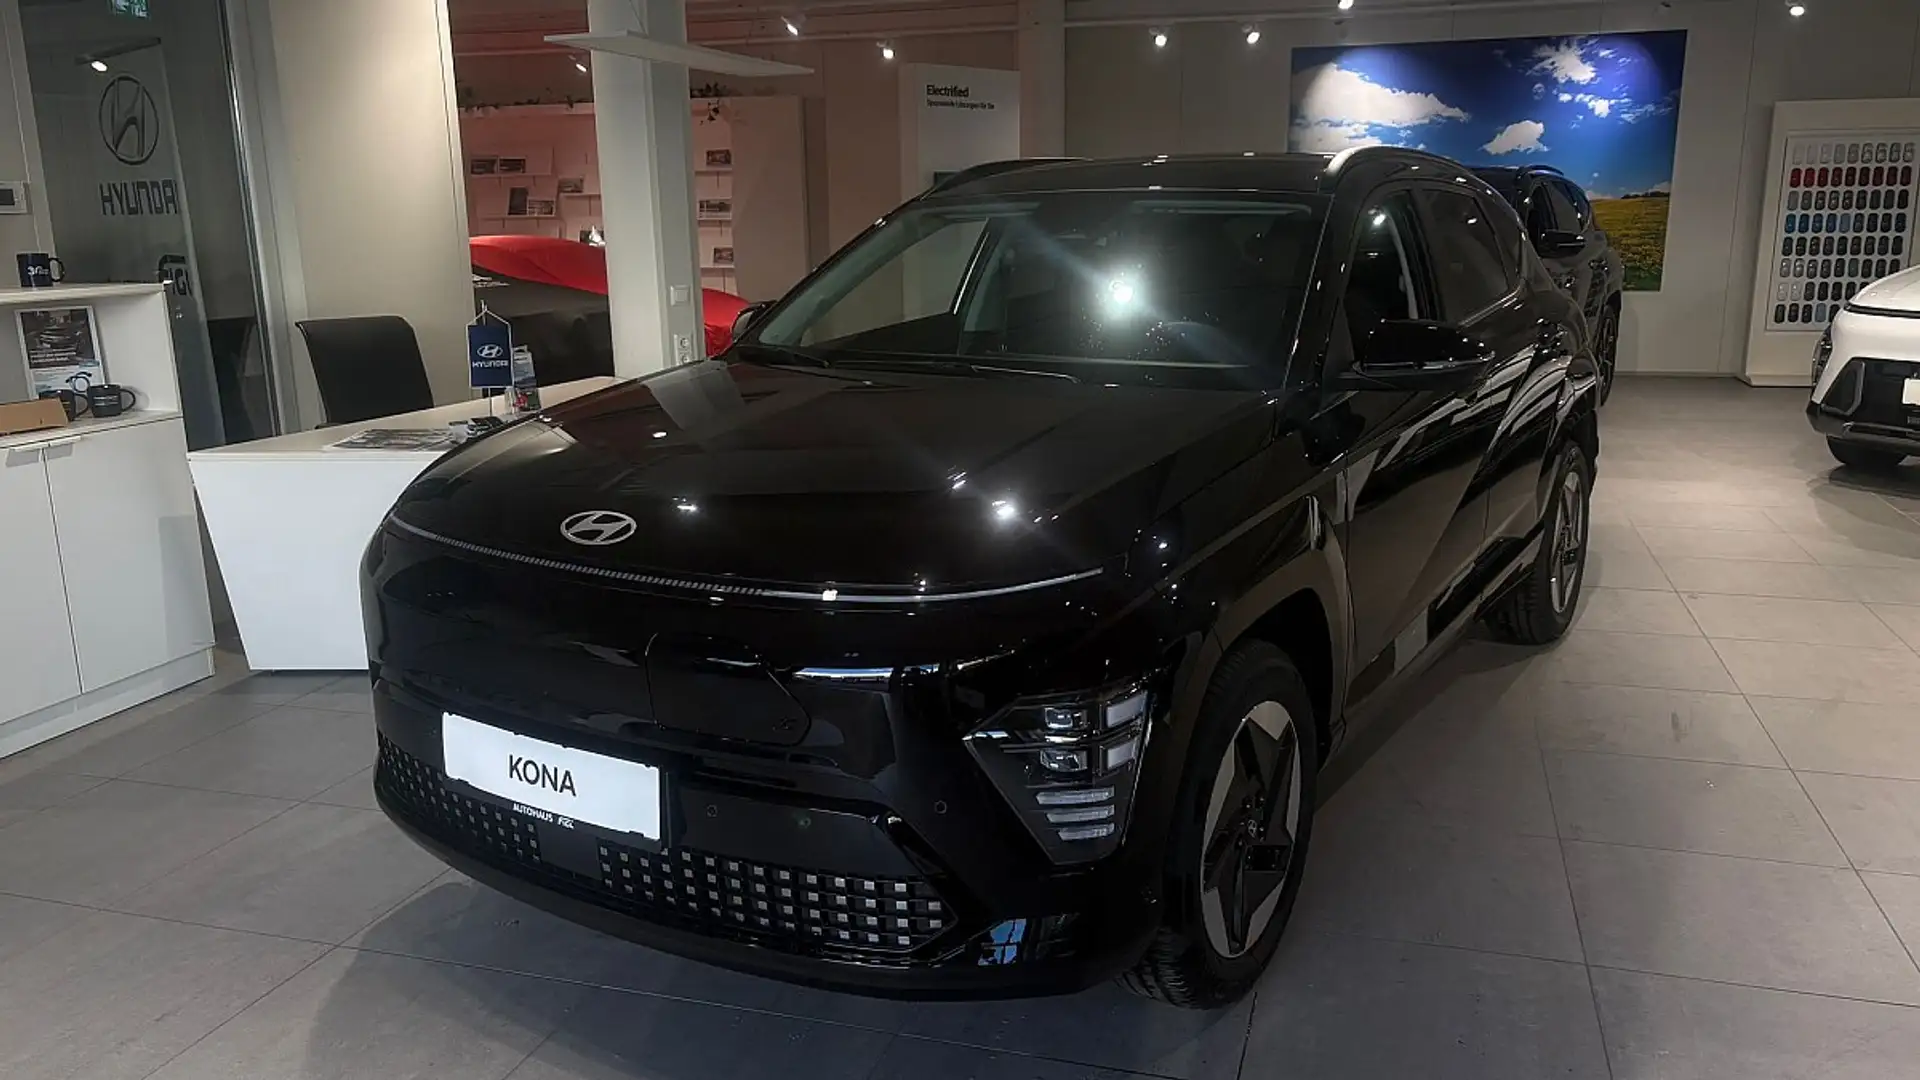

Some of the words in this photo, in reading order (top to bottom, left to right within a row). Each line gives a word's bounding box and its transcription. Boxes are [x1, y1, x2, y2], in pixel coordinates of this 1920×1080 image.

[927, 84, 969, 97] Electrified
[472, 360, 509, 368] HYUNDAI
[509, 754, 576, 796] KONA
[512, 803, 553, 822] AUTOHAUS
